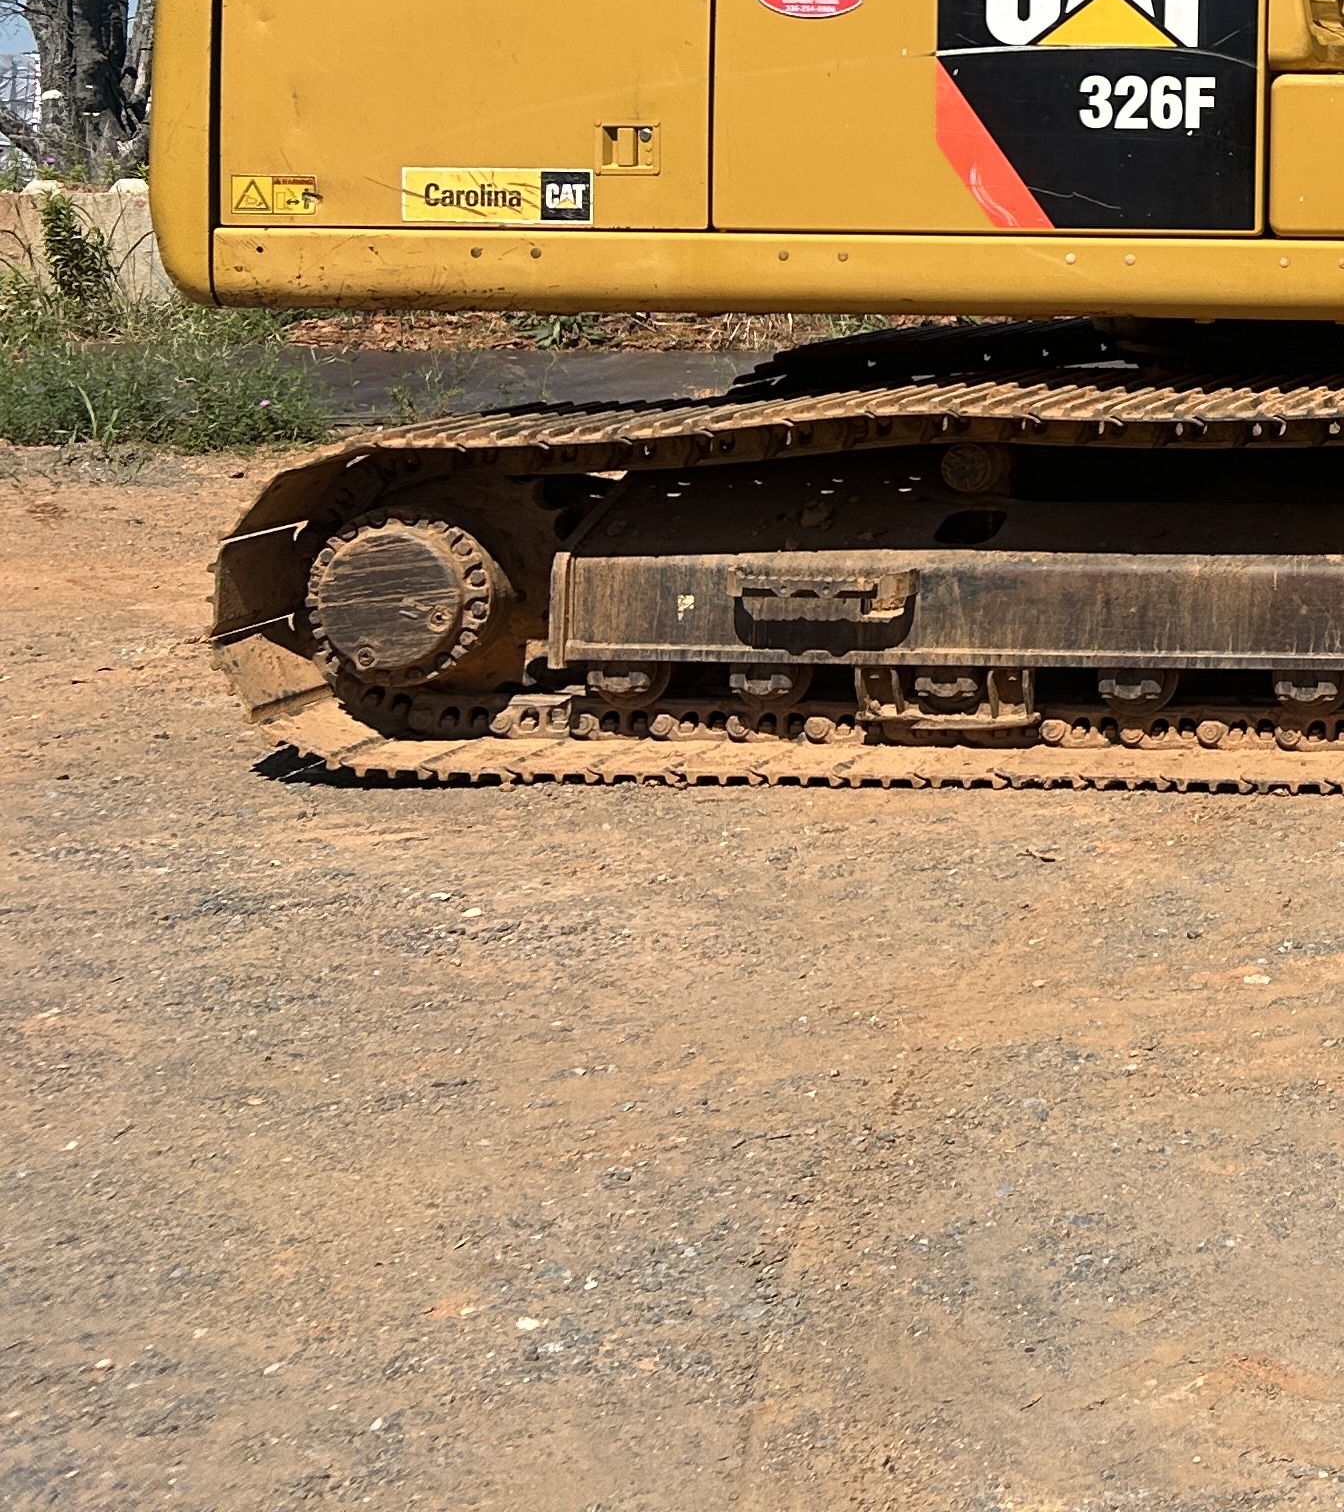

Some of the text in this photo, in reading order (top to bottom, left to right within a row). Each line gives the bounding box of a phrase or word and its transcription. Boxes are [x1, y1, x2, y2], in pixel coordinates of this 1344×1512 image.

[1079, 75, 1216, 129] 326F
[424, 183, 588, 210] Carolina CAT
